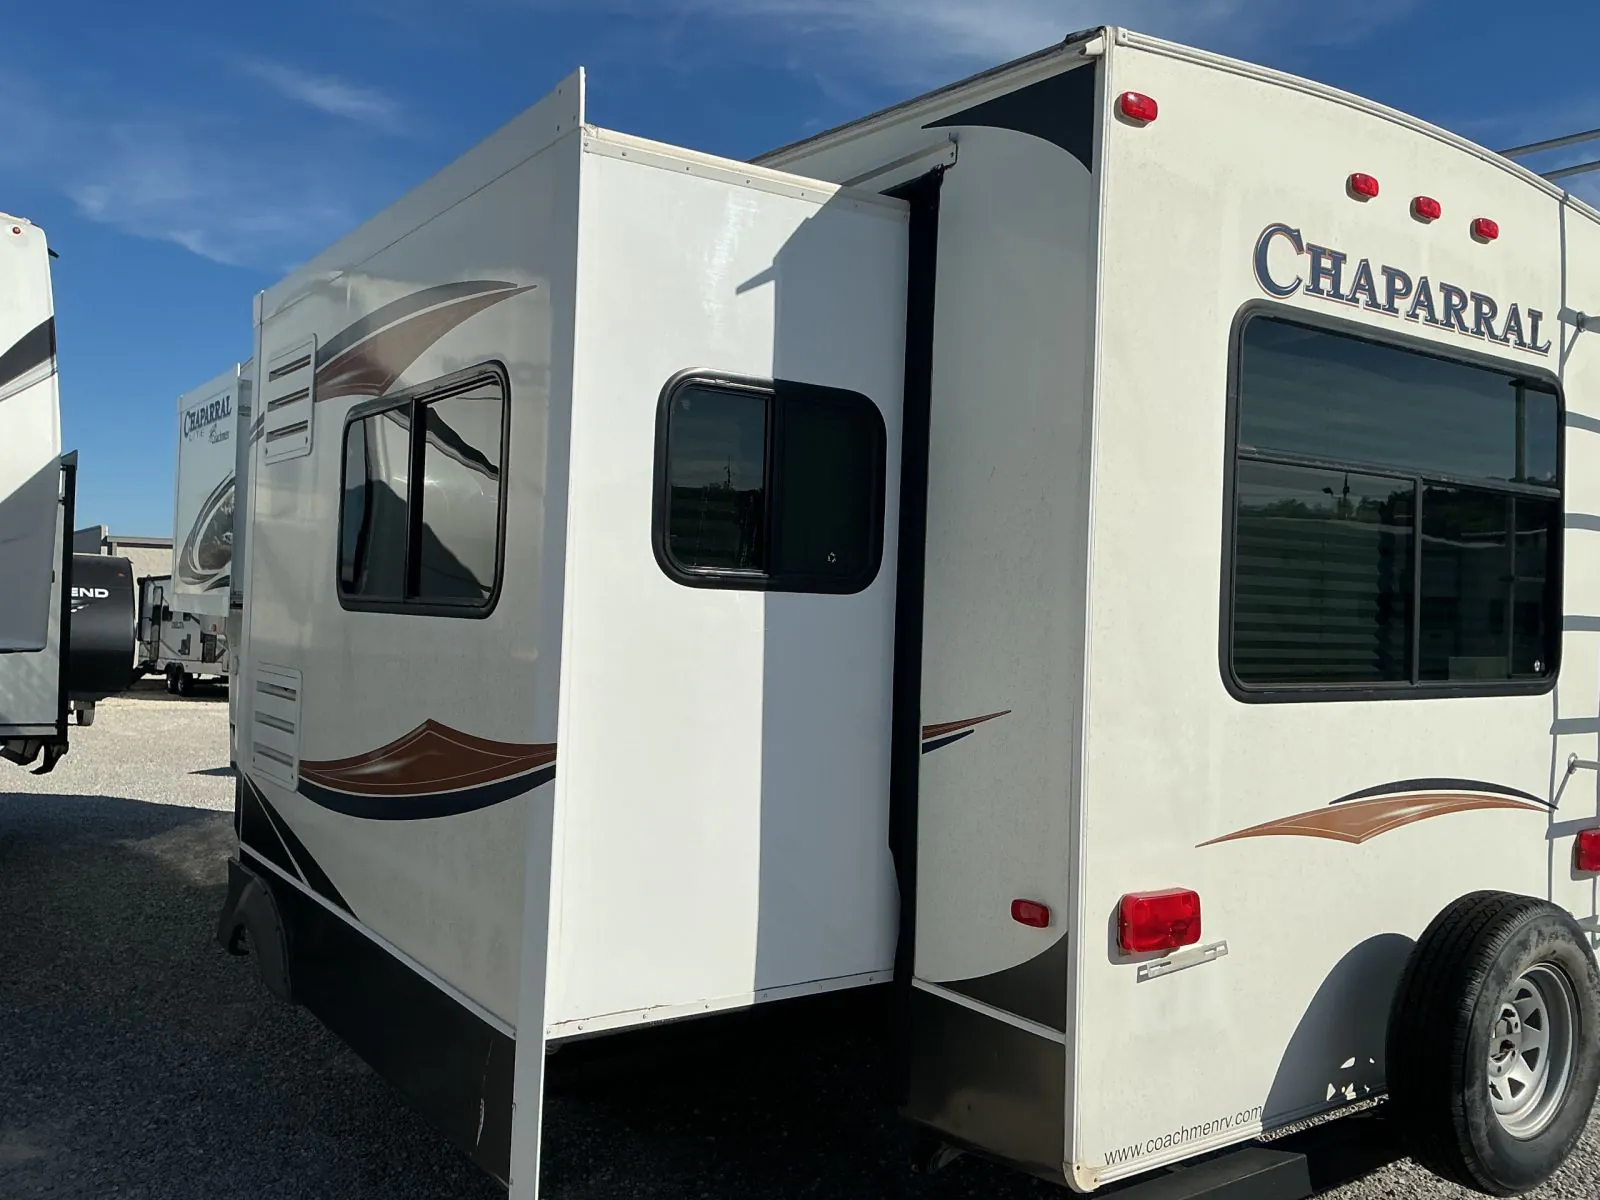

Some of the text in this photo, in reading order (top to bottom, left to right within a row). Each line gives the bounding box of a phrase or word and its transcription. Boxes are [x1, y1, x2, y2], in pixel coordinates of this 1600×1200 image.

[1253, 222, 1552, 356] CHAPARRAL
[184, 395, 232, 438] CHAPARRAL
[1104, 1105, 1262, 1166] www.coachmenrv.com
